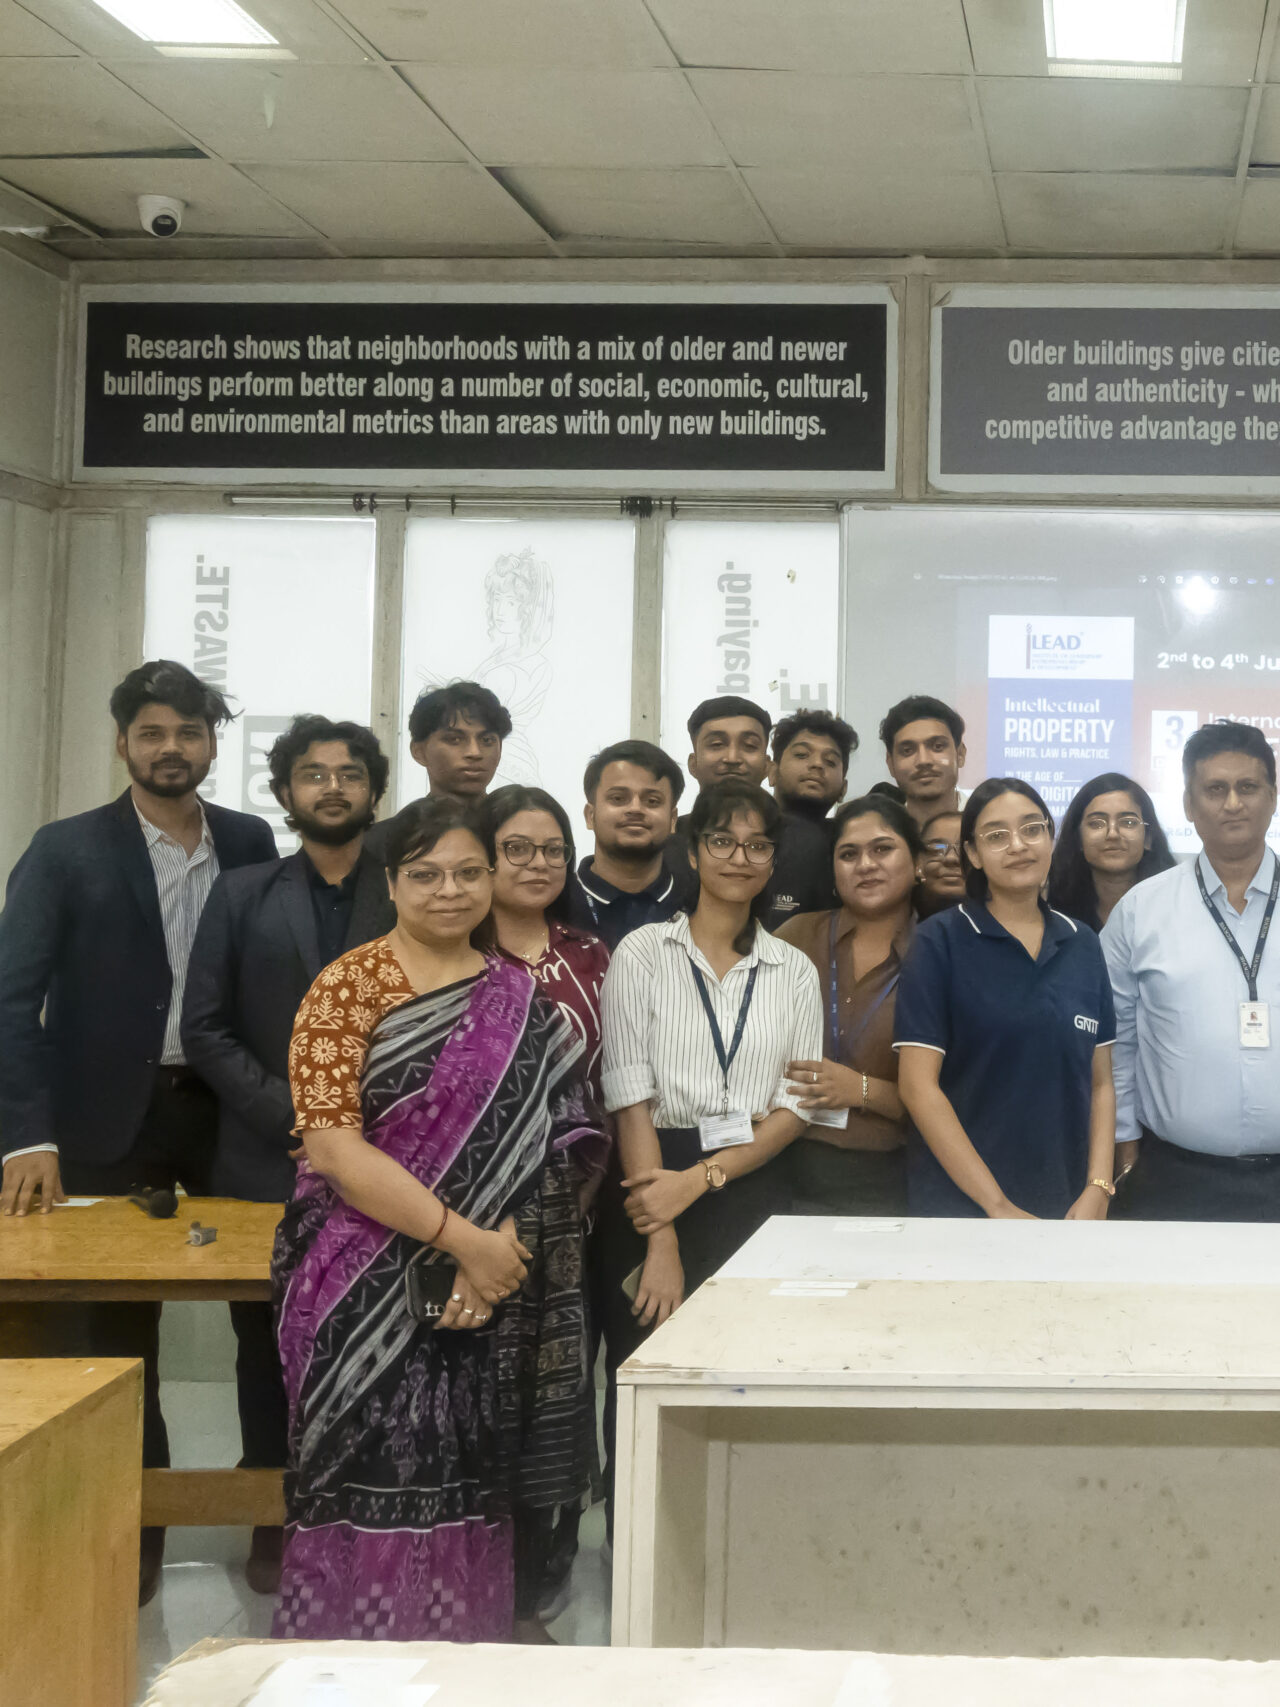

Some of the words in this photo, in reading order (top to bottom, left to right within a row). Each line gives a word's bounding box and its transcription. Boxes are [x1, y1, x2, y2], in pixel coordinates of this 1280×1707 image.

[126, 334, 226, 359] Research
[233, 334, 300, 359] shows
[306, 334, 351, 359] that
[357, 333, 517, 365] neighborhoods
[523, 334, 570, 360] with
[576, 340, 590, 360] a
[597, 335, 635, 360] mix
[641, 335, 663, 360] of
[669, 335, 725, 360] older
[732, 335, 773, 360] and
[780, 341, 847, 361] newer
[1008, 339, 1066, 365] Older
[1073, 339, 1173, 371] buildings
[1180, 340, 1225, 371] give
[104, 370, 201, 401] buildings
[208, 371, 293, 402] perform
[300, 371, 367, 396] better
[373, 371, 433, 402] along
[440, 377, 454, 396] a
[461, 372, 544, 398] number
[550, 372, 572, 397] of
[578, 372, 649, 402] social,
[656, 371, 769, 401] economic,
[776, 372, 868, 402] cultural,
[1046, 376, 1087, 402] and
[1094, 376, 1228, 407] authenticity
[143, 407, 183, 432] and
[190, 408, 345, 433] environmental
[352, 408, 433, 433] metrics
[439, 408, 489, 434] than
[496, 414, 557, 434] areas
[563, 409, 609, 434] with
[616, 409, 662, 439] only
[668, 414, 713, 434] new
[720, 409, 826, 440] buildings.
[984, 412, 1113, 445] competitive
[1120, 414, 1236, 445] advantage
[1157, 652, 1188, 669] 2nd
[1192, 655, 1215, 670] to
[1220, 654, 1249, 670] 4th
[1005, 698, 1100, 713] Intellectual
[1004, 718, 1115, 743] PROPERTY
[1040, 748, 1059, 759] LAW
[1069, 749, 1110, 760] PRACTICE
[1035, 771, 1052, 782] AGE
